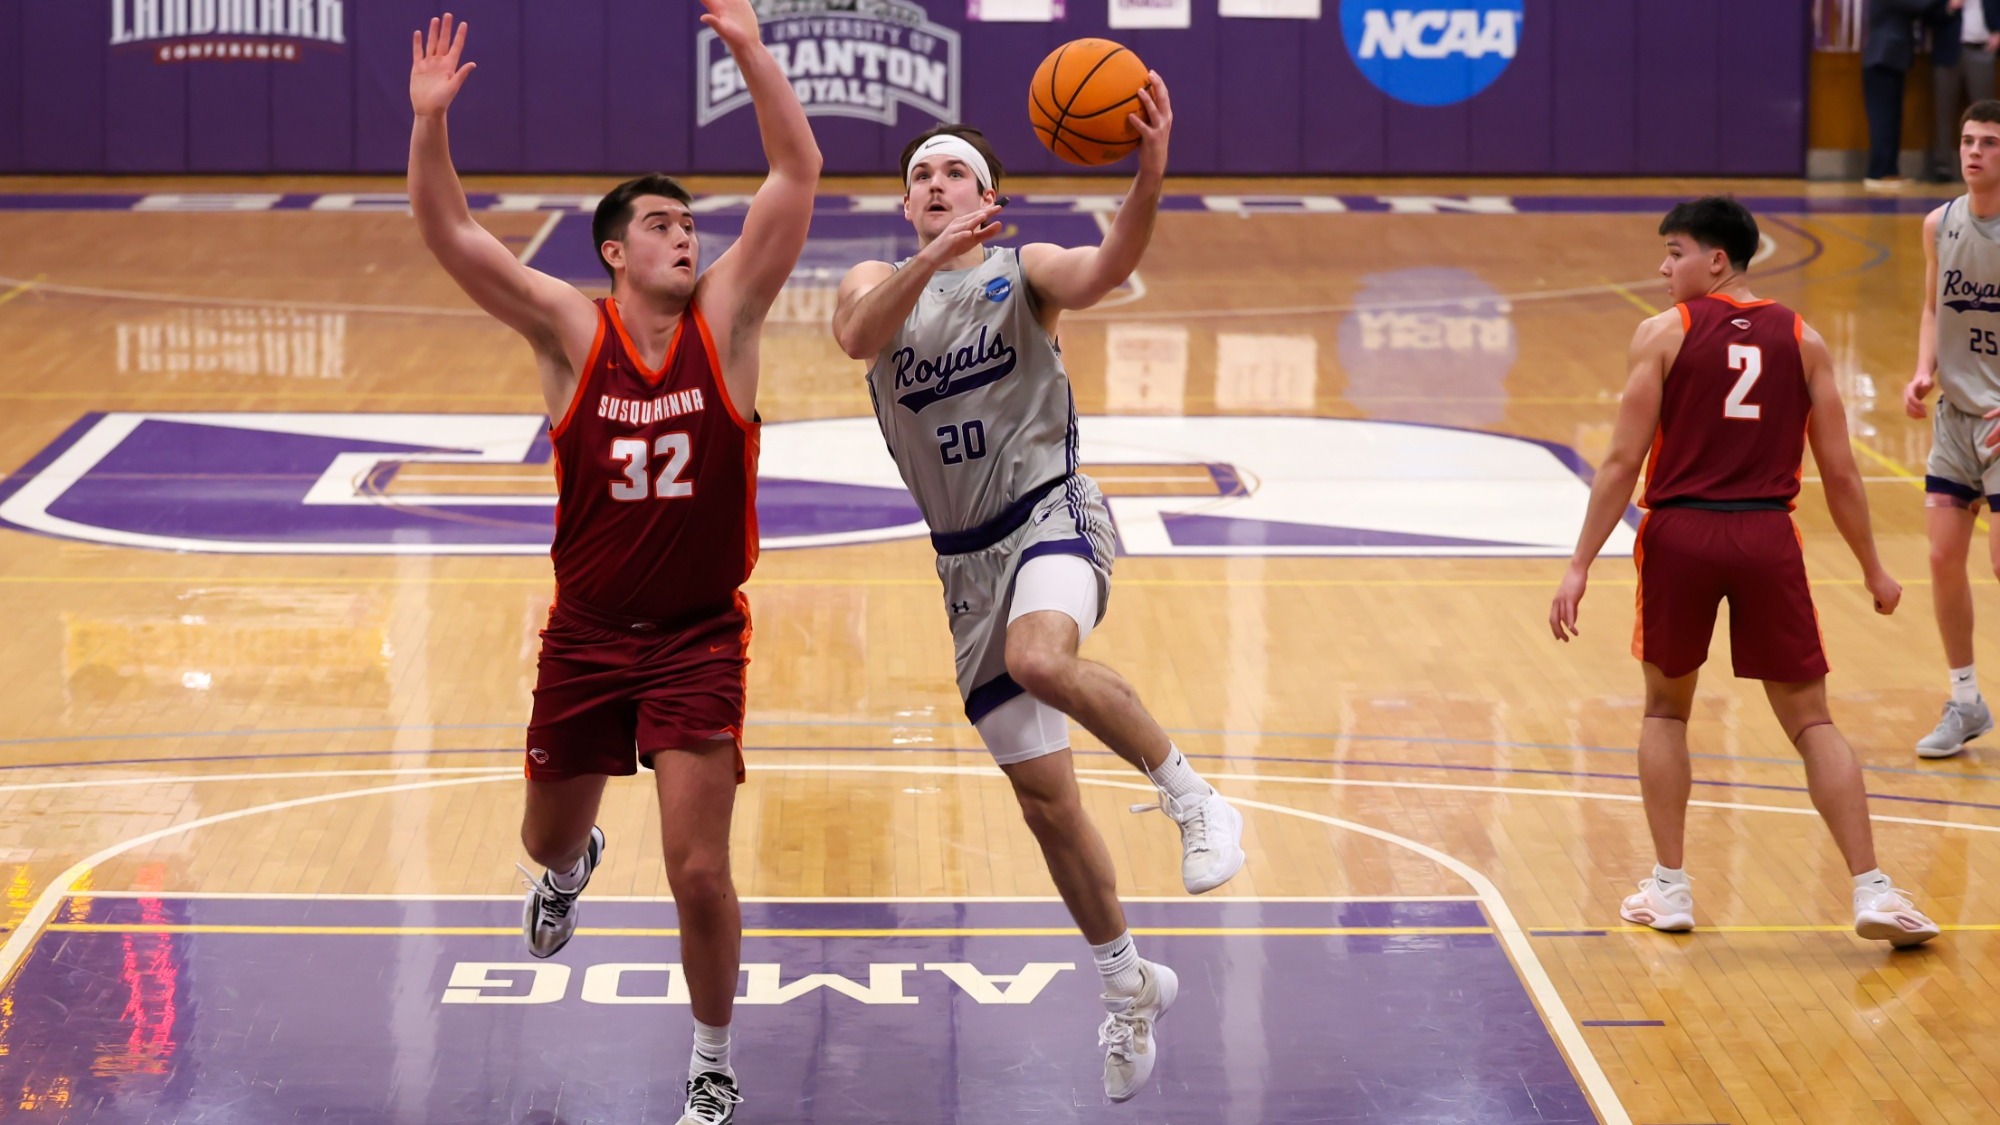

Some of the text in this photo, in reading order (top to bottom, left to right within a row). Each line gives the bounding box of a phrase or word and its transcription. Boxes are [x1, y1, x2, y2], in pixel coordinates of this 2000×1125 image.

[110, 0, 346, 45] LANDMARK
[772, 18, 901, 46] UNIVERSITY
[908, 30, 936, 55] OF
[1357, 9, 1517, 59] NCAA
[710, 37, 947, 102] SRANTON
[792, 75, 884, 107] OYALS
[891, 325, 1008, 394] Royals
[1970, 327, 1998, 356] 25
[1723, 342, 1763, 420] 2
[936, 418, 988, 466] 20
[609, 431, 695, 502] 32
[440, 961, 1076, 1005] AMDG
